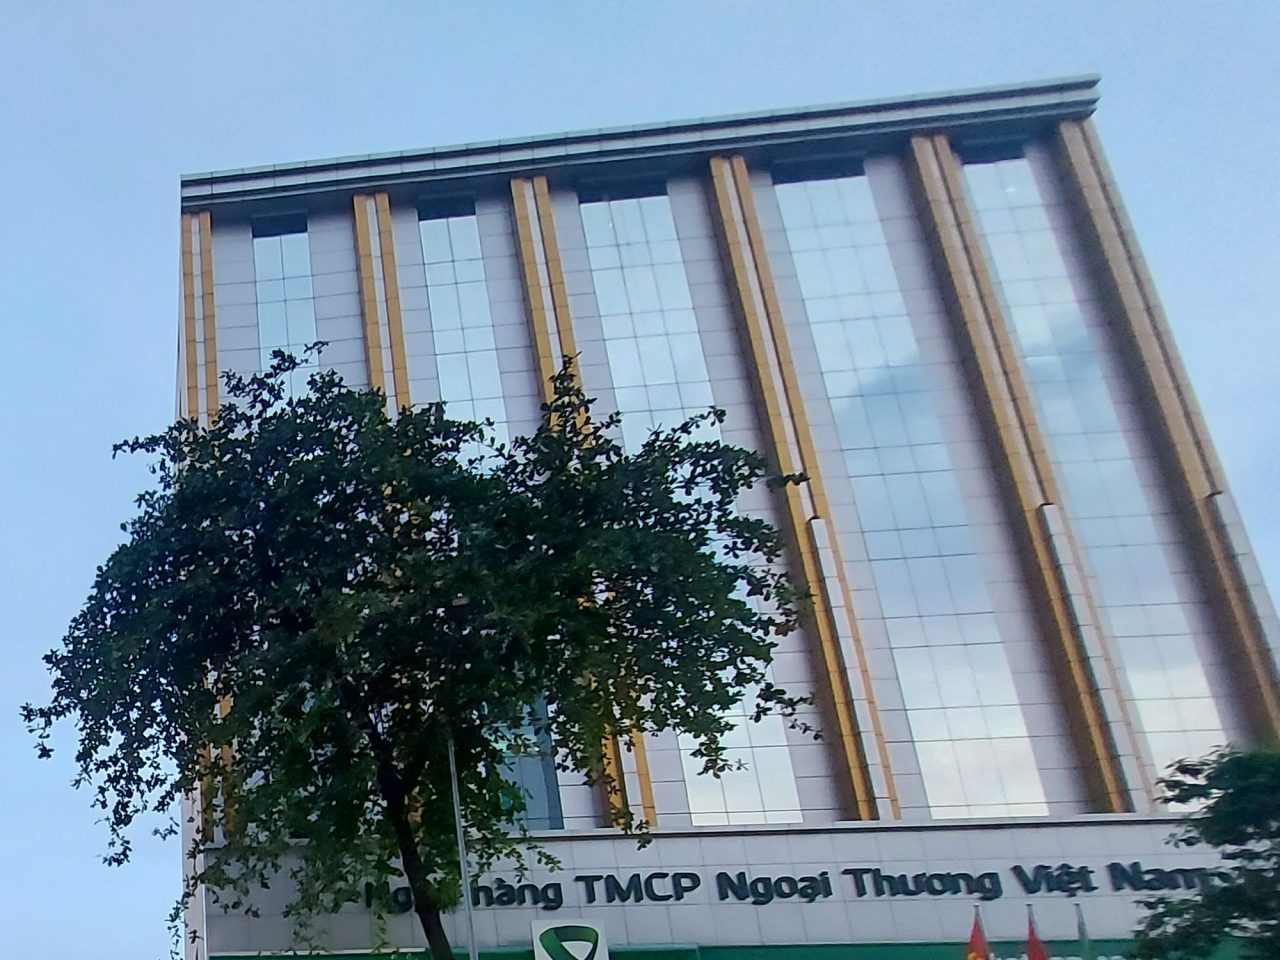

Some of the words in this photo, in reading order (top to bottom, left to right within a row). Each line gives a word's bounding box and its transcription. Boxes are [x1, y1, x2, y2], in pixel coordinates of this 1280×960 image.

[472, 876, 563, 911] hàng
[574, 872, 701, 904] TMCP
[716, 870, 833, 905] Ngoại
[840, 867, 1003, 901] Thương
[1010, 863, 1099, 898] Việt
